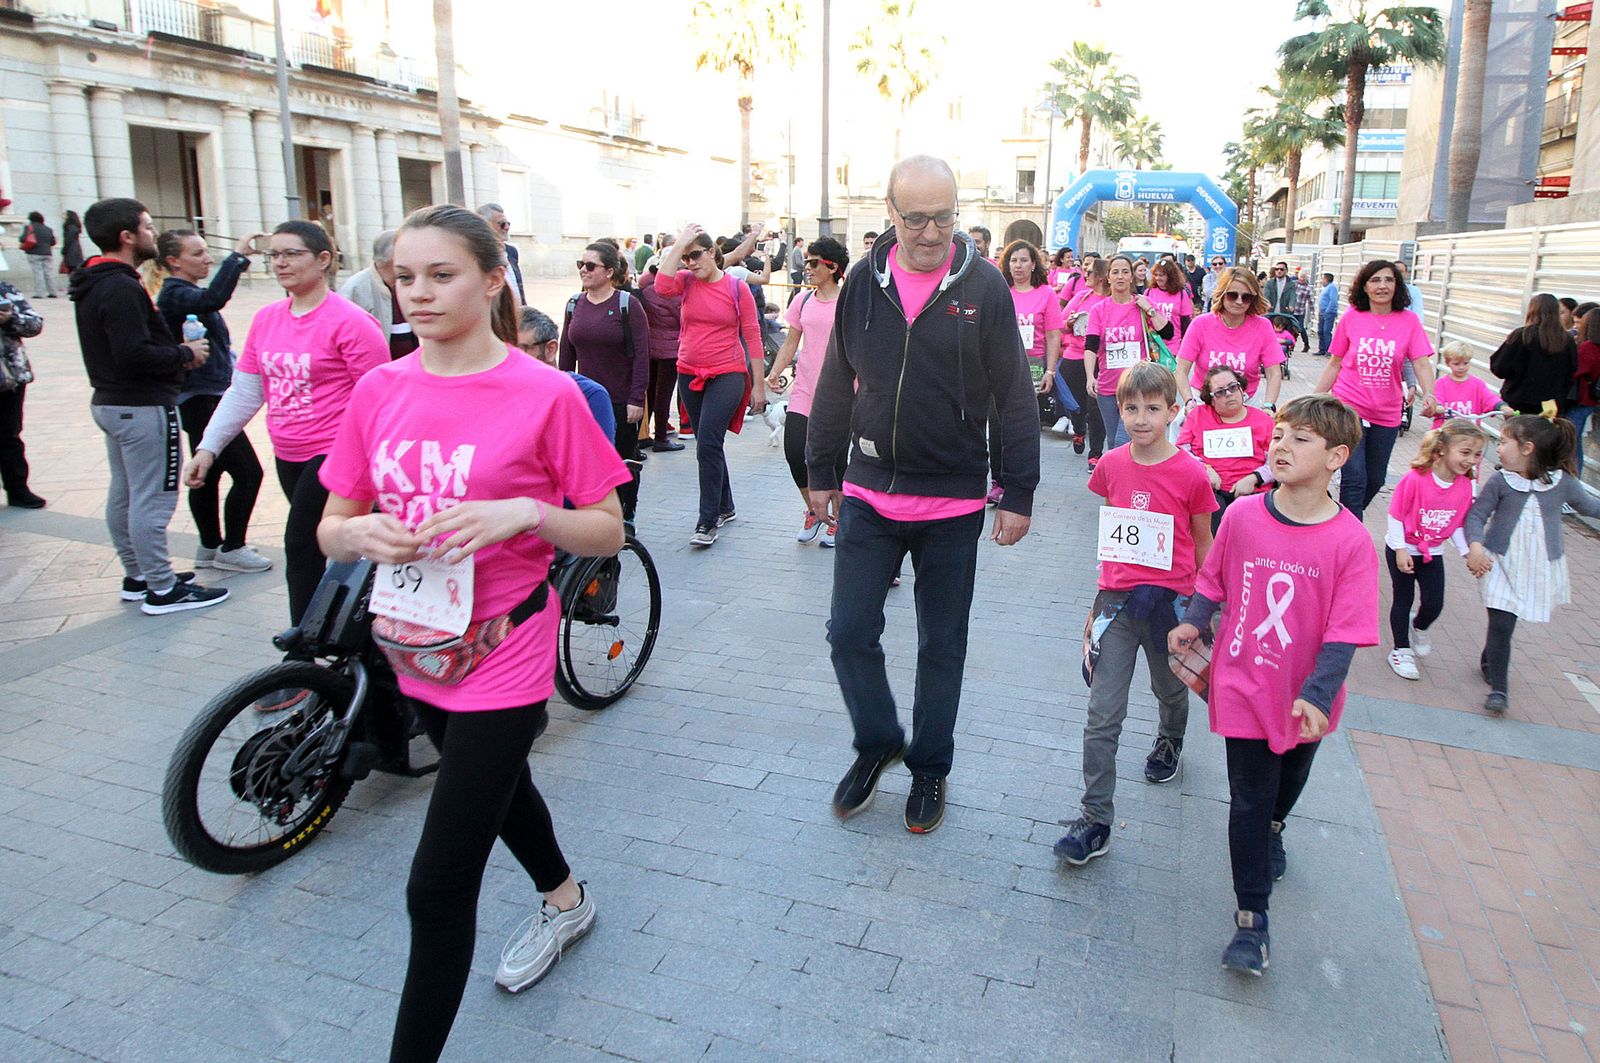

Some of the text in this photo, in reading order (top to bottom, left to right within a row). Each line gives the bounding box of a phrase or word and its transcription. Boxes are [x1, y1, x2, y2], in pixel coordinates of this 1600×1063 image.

[267, 83, 373, 112] AUNTAMIENTO
[1064, 182, 1093, 209] DEPORTES
[1138, 192, 1174, 200] HUELVA
[1196, 186, 1223, 214] DEPORTES
[1016, 313, 1034, 326] M
[1105, 325, 1136, 342] KM
[1108, 350, 1129, 361] 518
[1358, 337, 1396, 356] KM
[261, 351, 312, 379] KM
[1208, 351, 1246, 370] KM
[1357, 353, 1393, 369] POR
[1207, 437, 1235, 449] 176
[372, 440, 477, 497] KM
[1110, 524, 1140, 546] 48
[1255, 557, 1320, 578] ante todo tú
[282, 804, 331, 849] MAXXIS
